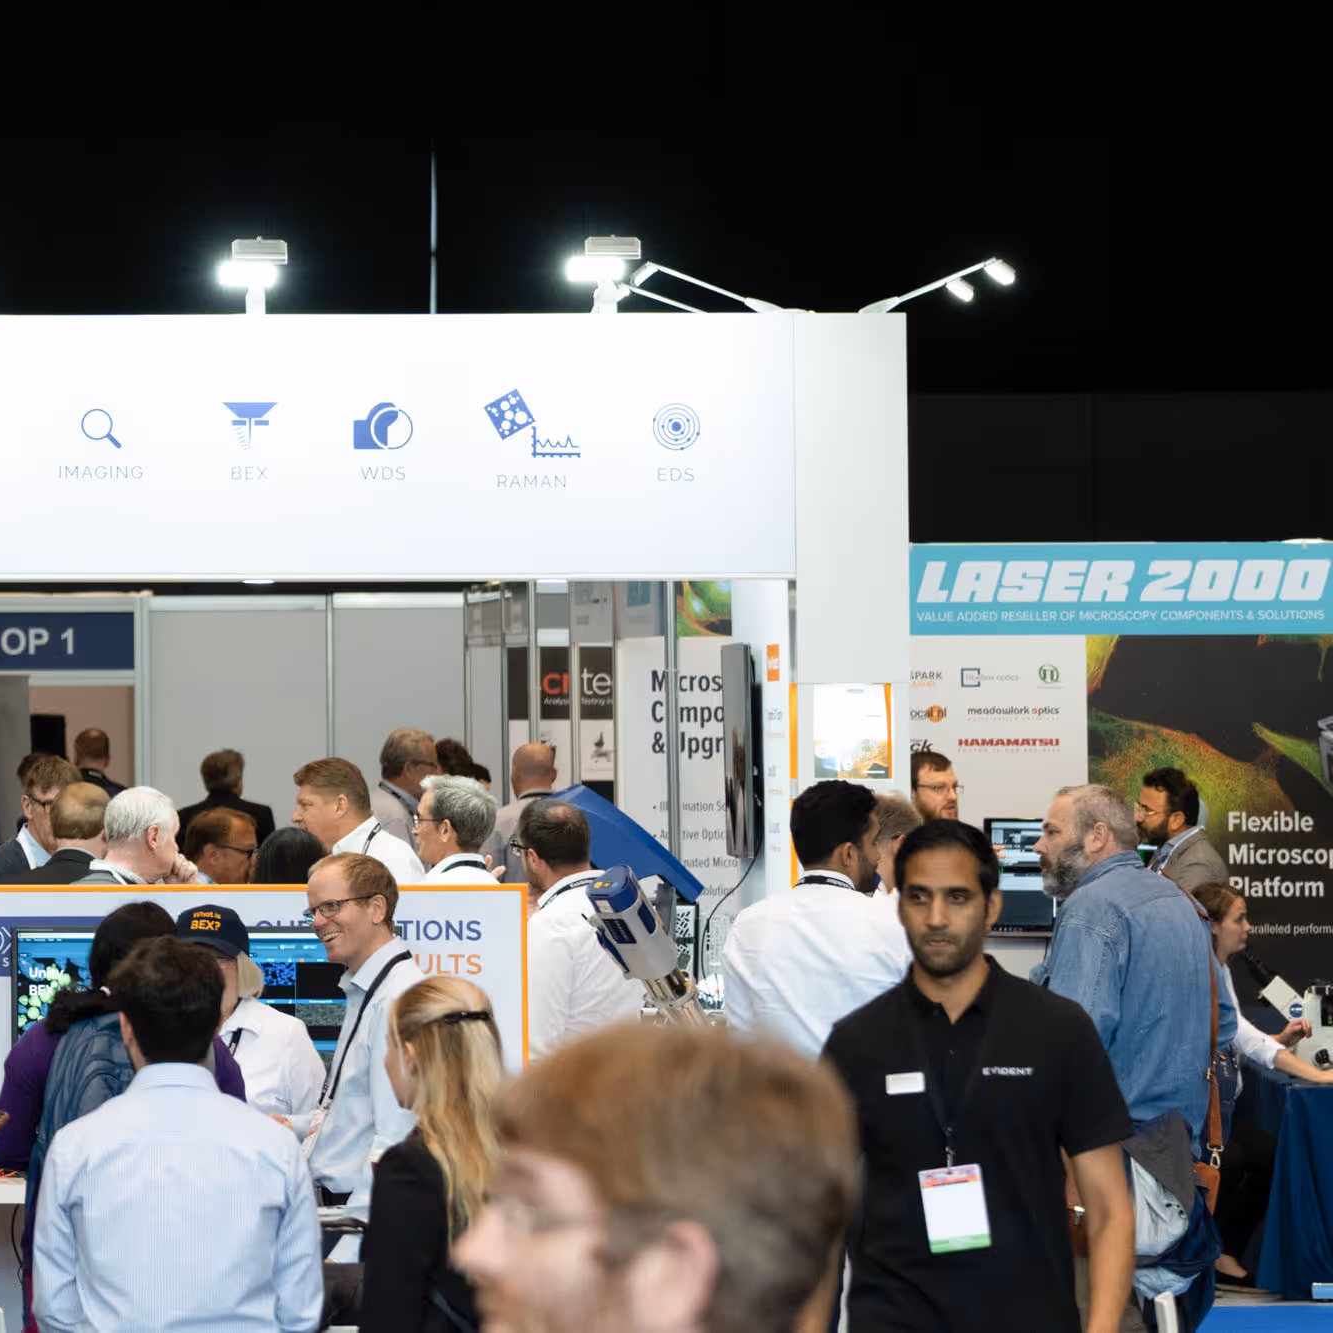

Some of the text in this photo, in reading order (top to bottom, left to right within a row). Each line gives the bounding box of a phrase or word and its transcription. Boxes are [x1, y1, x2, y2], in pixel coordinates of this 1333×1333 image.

[57, 465, 144, 481] IMAGING
[231, 466, 268, 481] BEX
[359, 466, 406, 481] WDS
[657, 467, 695, 482] EDS
[496, 474, 567, 489] RAMAN
[916, 558, 1331, 603] LASER 2000
[916, 609, 1325, 622] VALUE ADDED RESELLER OF MICROSCOPY COMPONENTS & SOLUTIONS
[61, 627, 74, 655] 1
[651, 732, 666, 754] &
[957, 738, 1061, 747] HAMAMATSU
[1228, 810, 1315, 833] Flexible
[1229, 876, 1325, 897] Platform
[190, 919, 222, 931] BEX?
[28, 967, 65, 980] Unity
[29, 984, 54, 996] BEX
[982, 1066, 1033, 1076] EVIDENT
